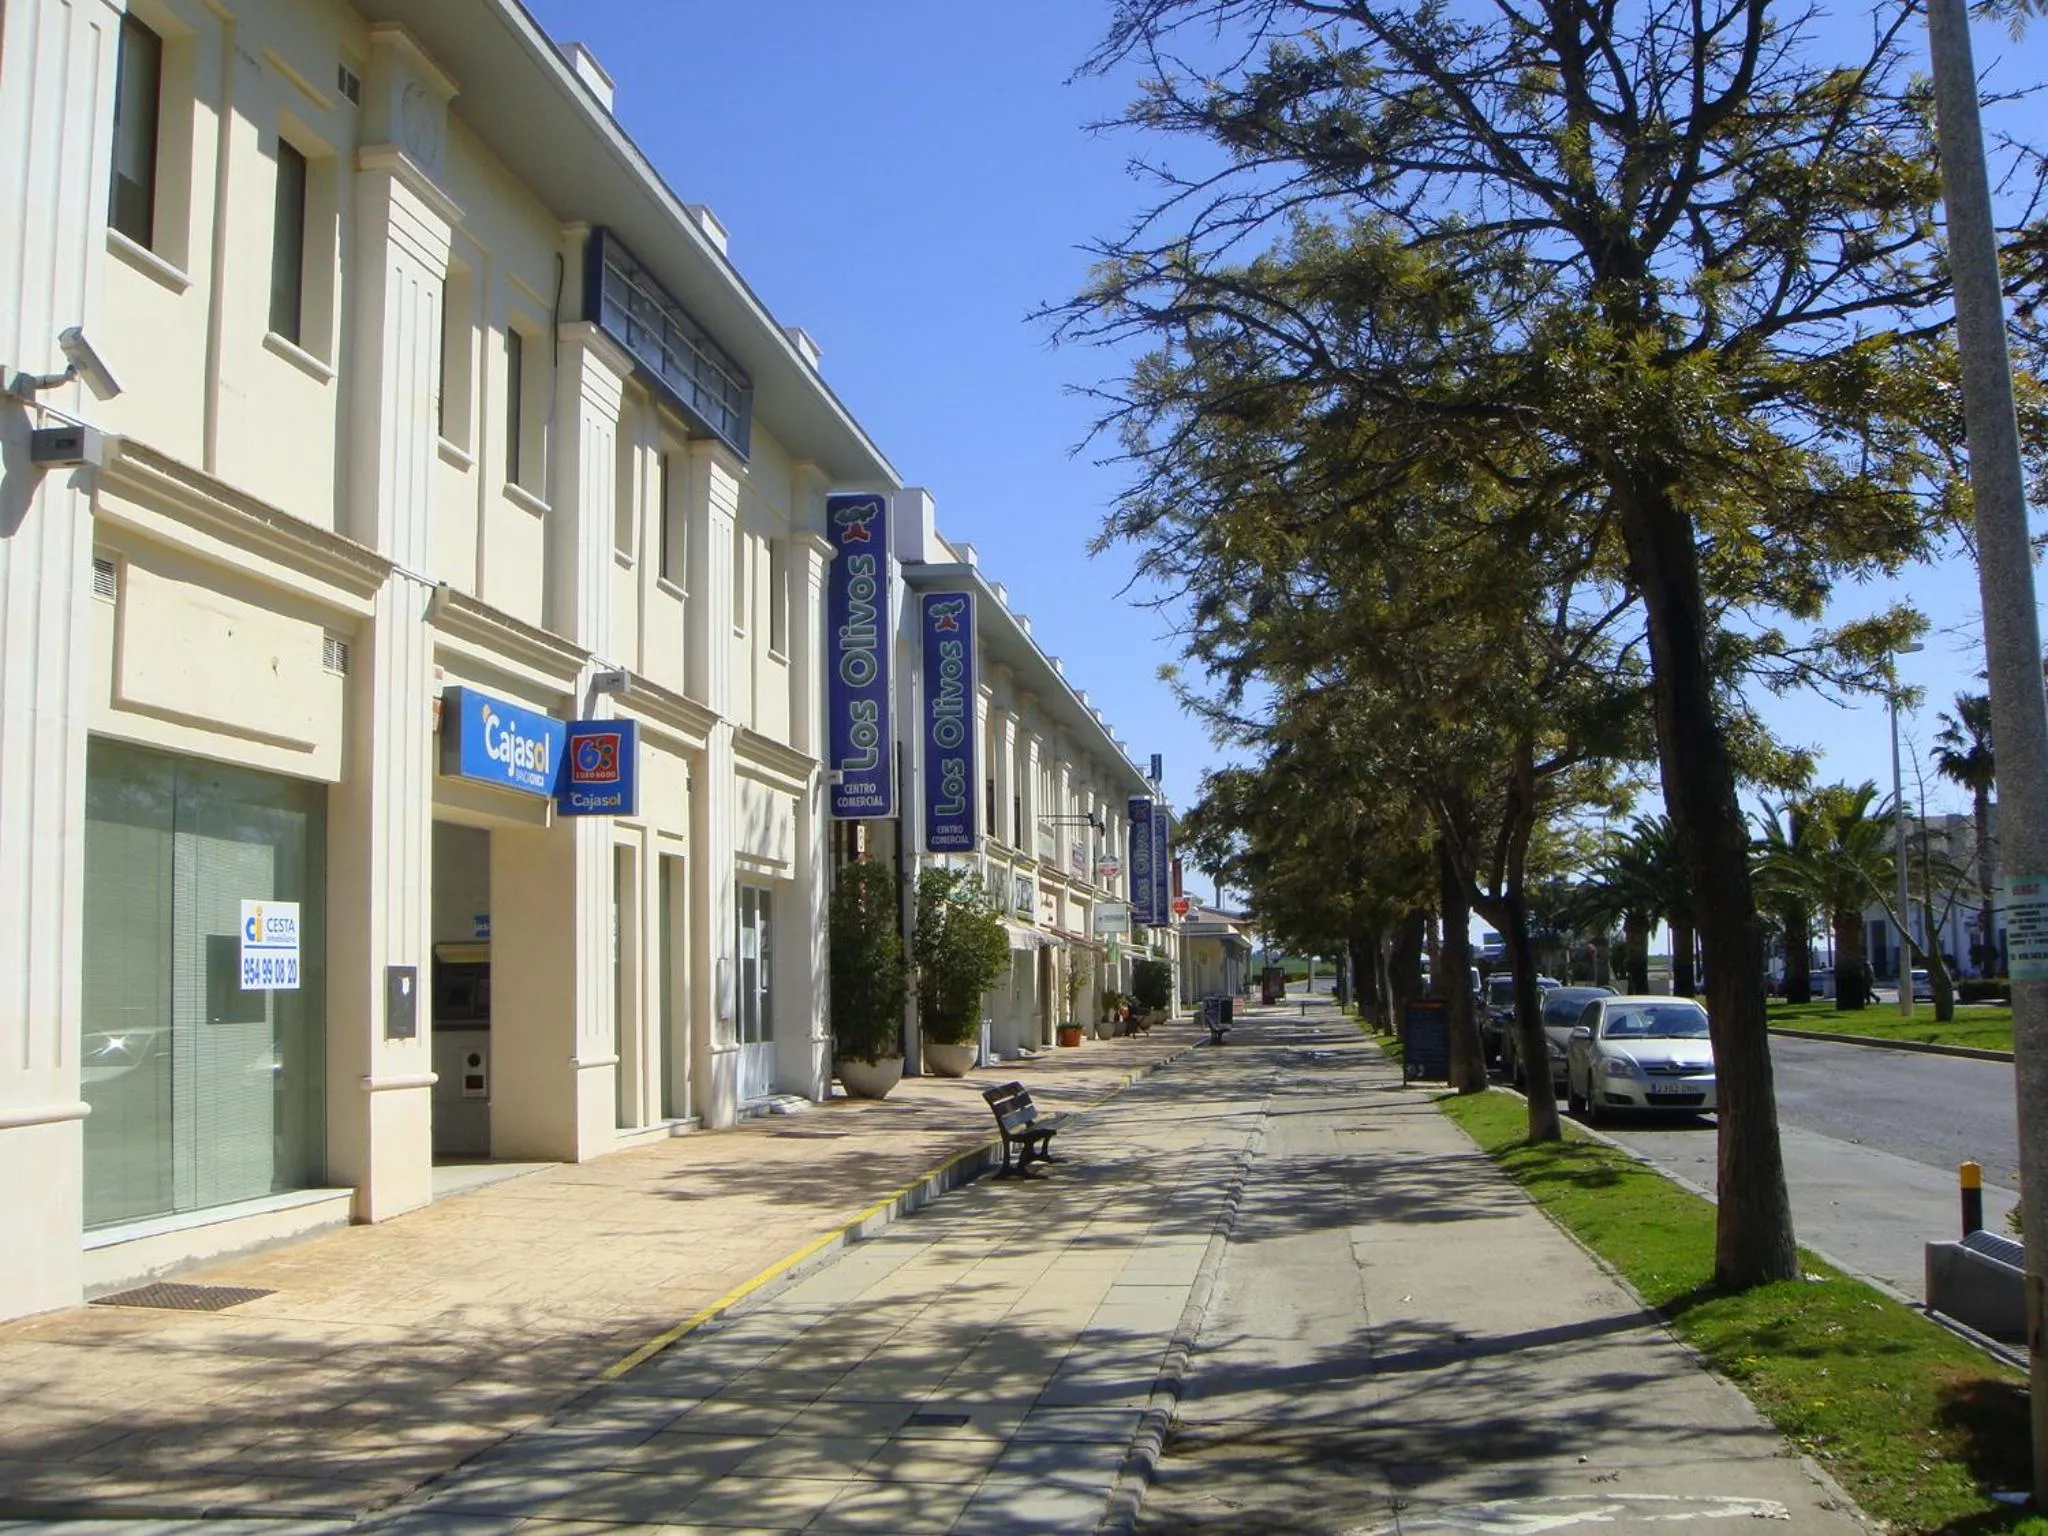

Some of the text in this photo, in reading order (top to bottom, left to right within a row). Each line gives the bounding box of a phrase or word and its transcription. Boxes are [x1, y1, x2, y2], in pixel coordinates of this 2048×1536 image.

[839, 554, 878, 771] Los Olivos
[933, 640, 965, 816] Los Olivos
[485, 714, 549, 777] Cajasol
[844, 783, 876, 795] CENTRO
[571, 792, 621, 810] Cajasol
[838, 796, 884, 808] COMERCIAL
[937, 825, 964, 834] CENTRO
[931, 834, 970, 845] COMERCIAL
[267, 918, 295, 933] CESTA
[244, 957, 297, 985] 954 99 08 20
